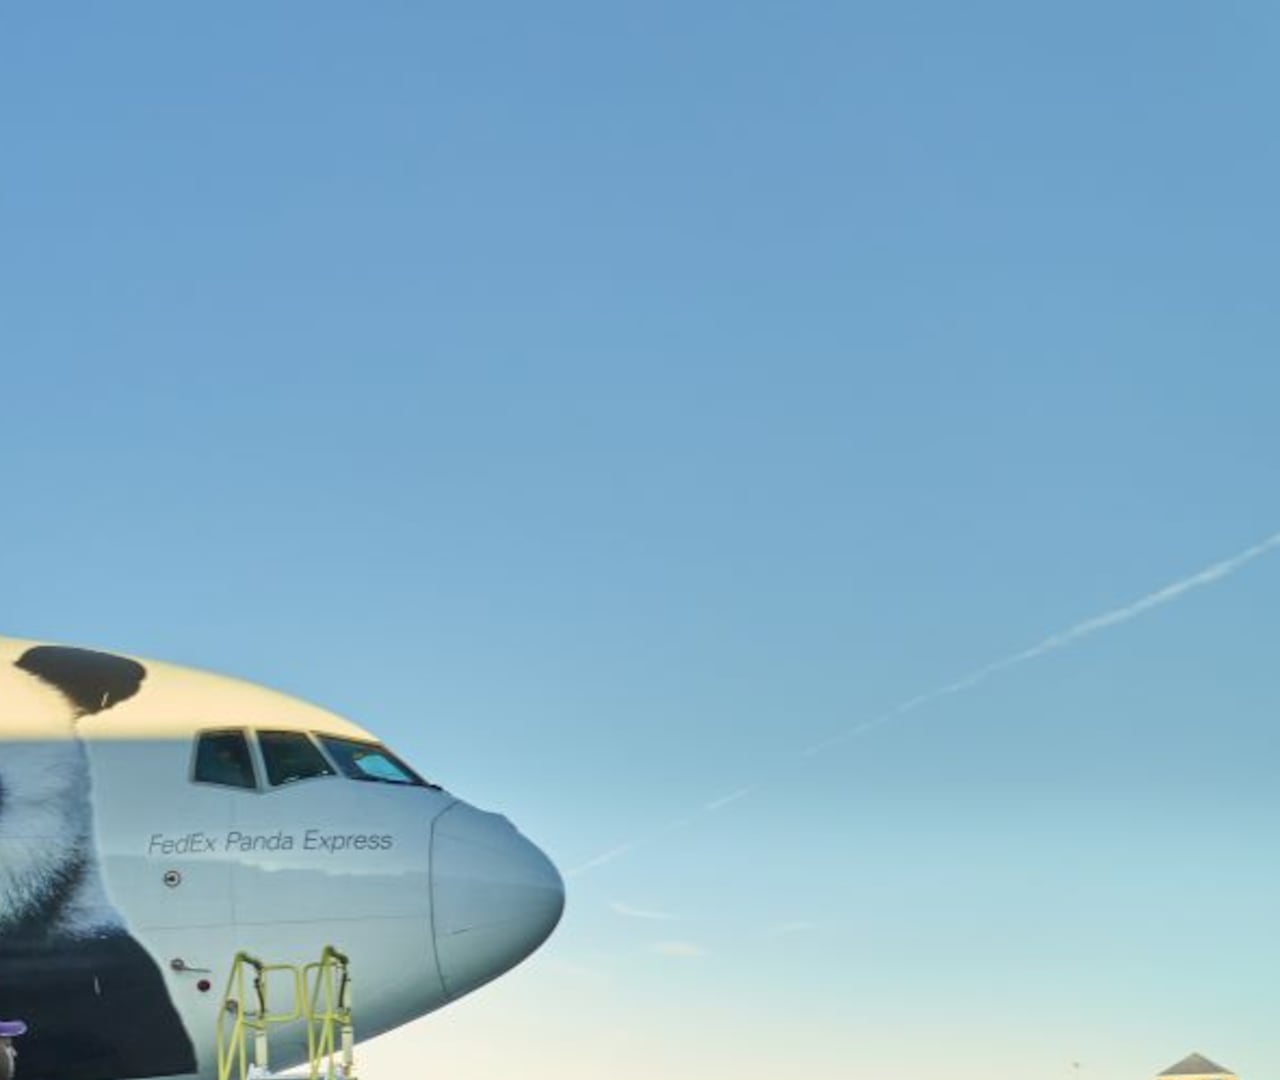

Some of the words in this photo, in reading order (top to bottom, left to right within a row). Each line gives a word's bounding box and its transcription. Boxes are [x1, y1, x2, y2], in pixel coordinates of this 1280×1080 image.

[148, 832, 218, 855] FedEx
[225, 830, 294, 852] Panda
[303, 829, 393, 854] Express
